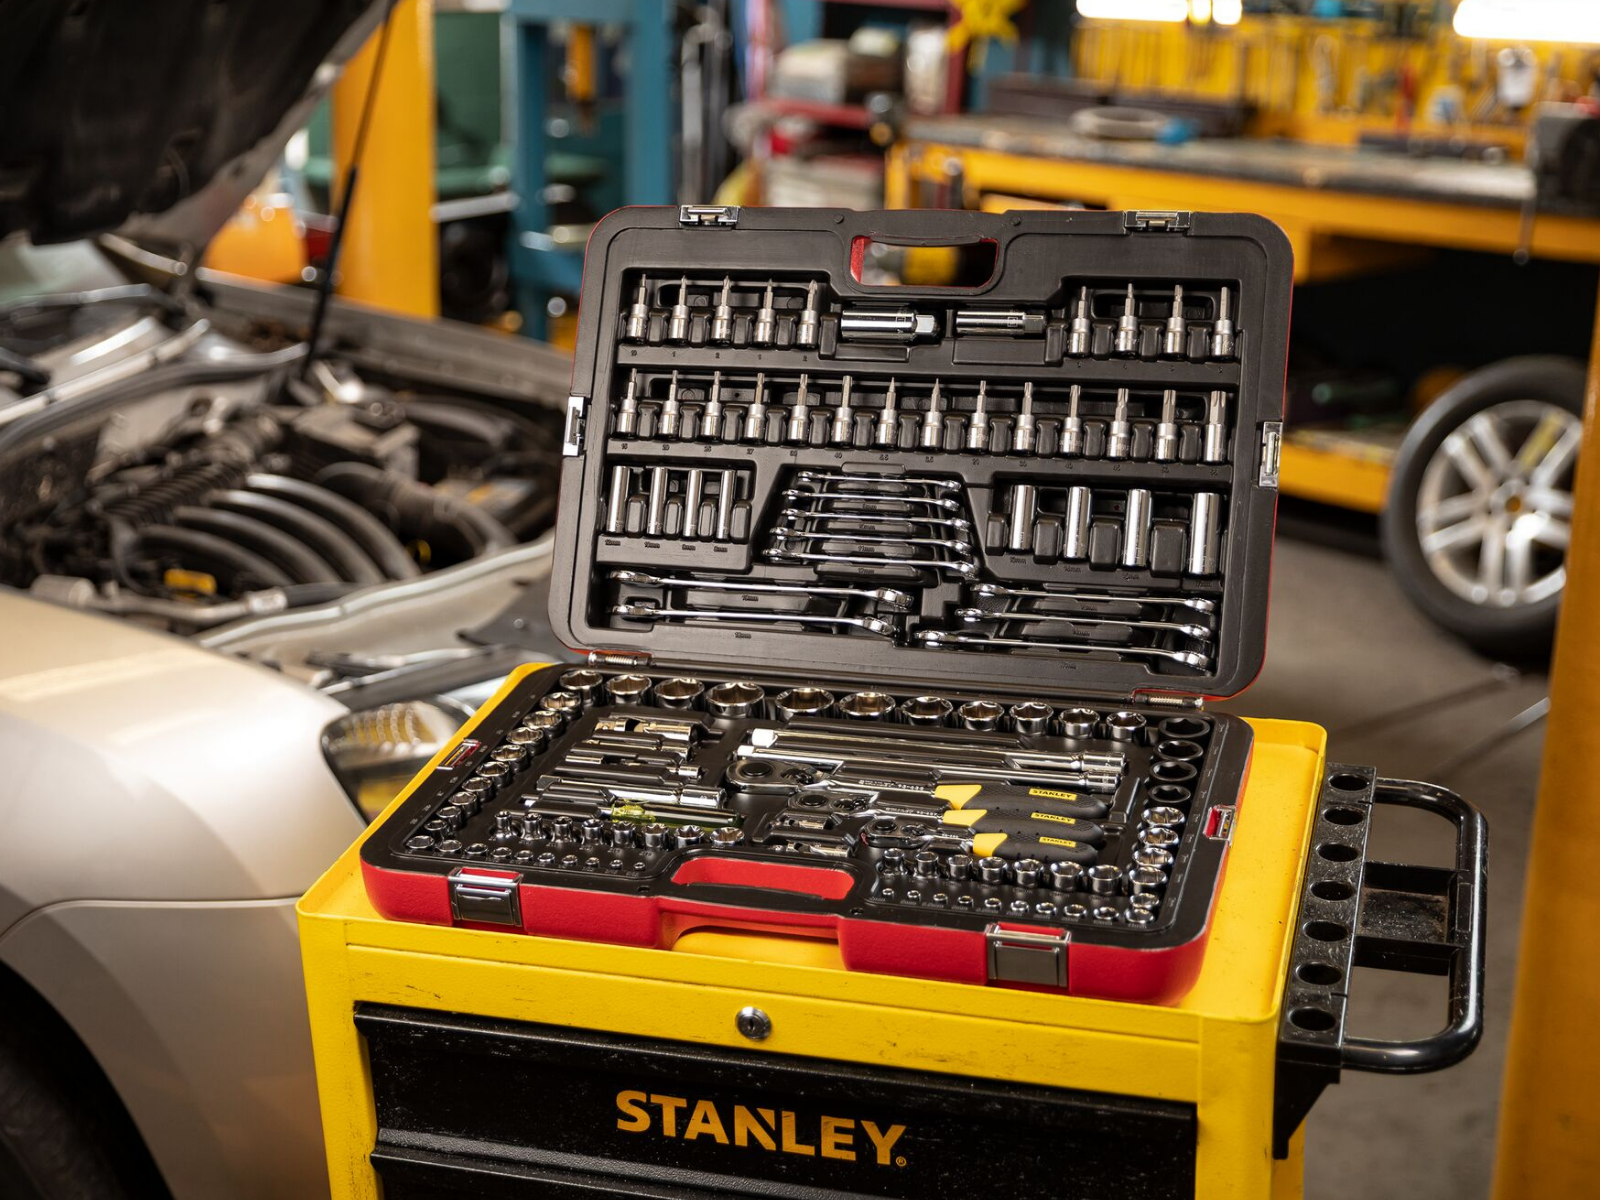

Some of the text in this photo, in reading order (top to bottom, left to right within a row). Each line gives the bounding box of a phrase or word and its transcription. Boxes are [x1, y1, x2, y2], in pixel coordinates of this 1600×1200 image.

[1032, 788, 1073, 799] STANLEY
[1035, 812, 1073, 823] STANLEY
[1041, 837, 1074, 847] STANLEY
[616, 1090, 907, 1166] STANLEY
